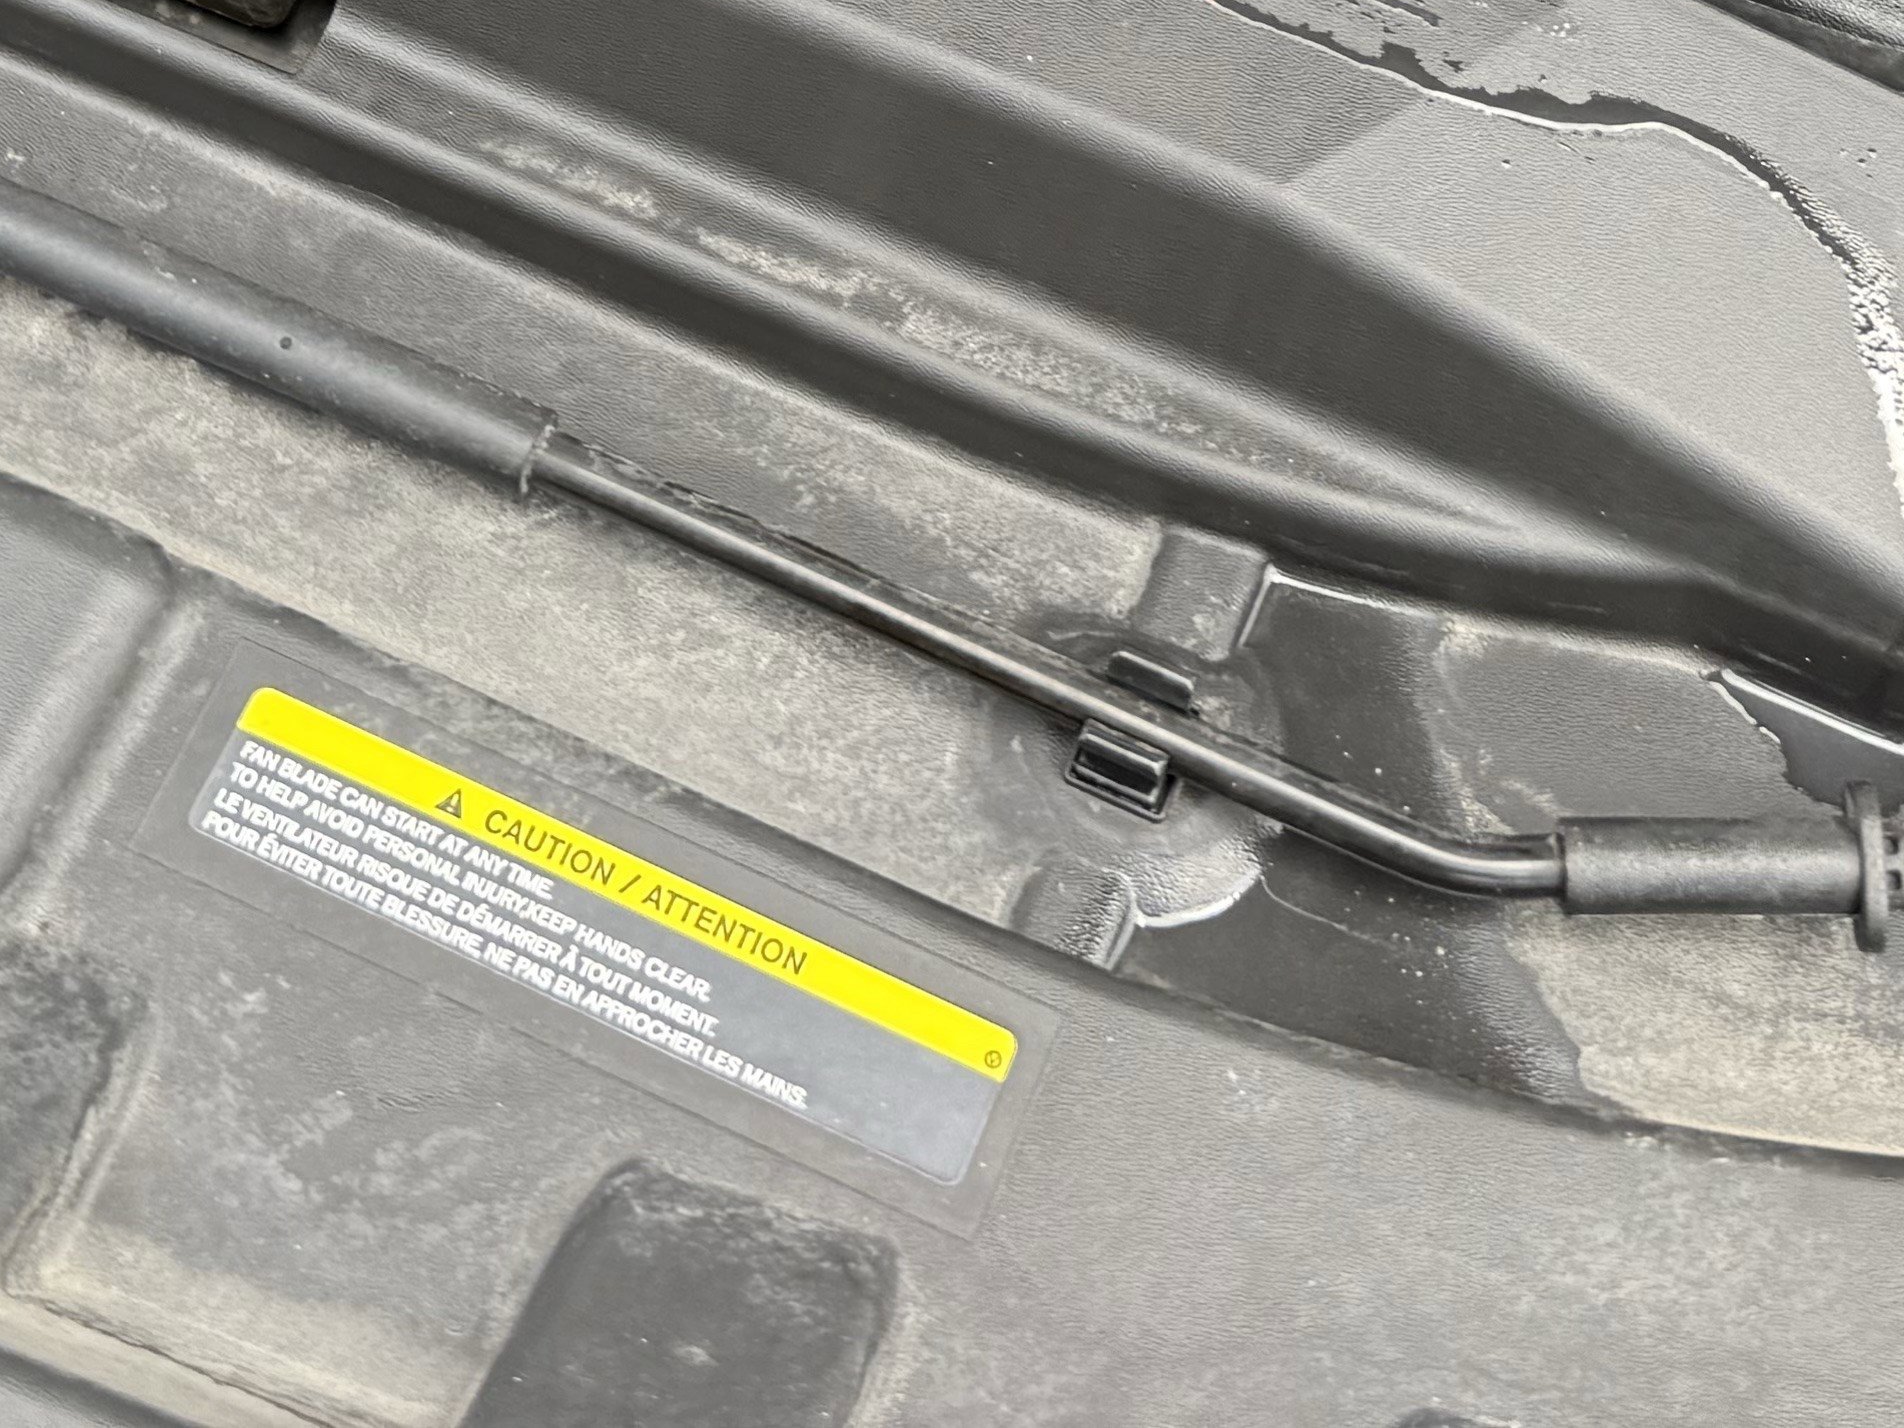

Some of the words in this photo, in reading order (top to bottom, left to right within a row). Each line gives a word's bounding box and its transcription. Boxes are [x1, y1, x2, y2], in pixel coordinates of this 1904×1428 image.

[211, 787, 246, 816] LE
[237, 799, 361, 869] VENTILATEUR
[353, 853, 432, 903] RISQUE
[425, 887, 462, 916] DE
[454, 896, 566, 964] DÉMARRER
[557, 943, 585, 972] À
[573, 955, 636, 997] TOUT
[627, 980, 723, 1038] MOMENT.
[225, 760, 260, 789] TO
[254, 774, 310, 813] HELP
[300, 796, 367, 840] AVOID
[359, 824, 467, 887] PERSONAL
[572, 922, 647, 970] HANDS
[640, 953, 718, 1003] CLEAR.
[237, 737, 284, 773] FAN
[275, 756, 344, 801] BLADE
[337, 785, 385, 820] CAN
[378, 804, 445, 848] START
[436, 831, 469, 859] AT
[461, 843, 511, 878] ANY
[503, 862, 560, 901] TIME.
[480, 806, 618, 886] CAUTION
[616, 873, 642, 895] /
[640, 880, 810, 976] ATTENTION
[199, 809, 263, 851] POUR
[255, 832, 328, 881] ÉVITER
[318, 865, 386, 909] TOUTE
[482, 941, 519, 970] NE
[511, 955, 559, 989] PAS
[552, 975, 586, 1002] EN
[579, 987, 706, 1058] APPROCHER
[700, 1044, 745, 1077] LES
[739, 1062, 815, 1110] MAINS.
